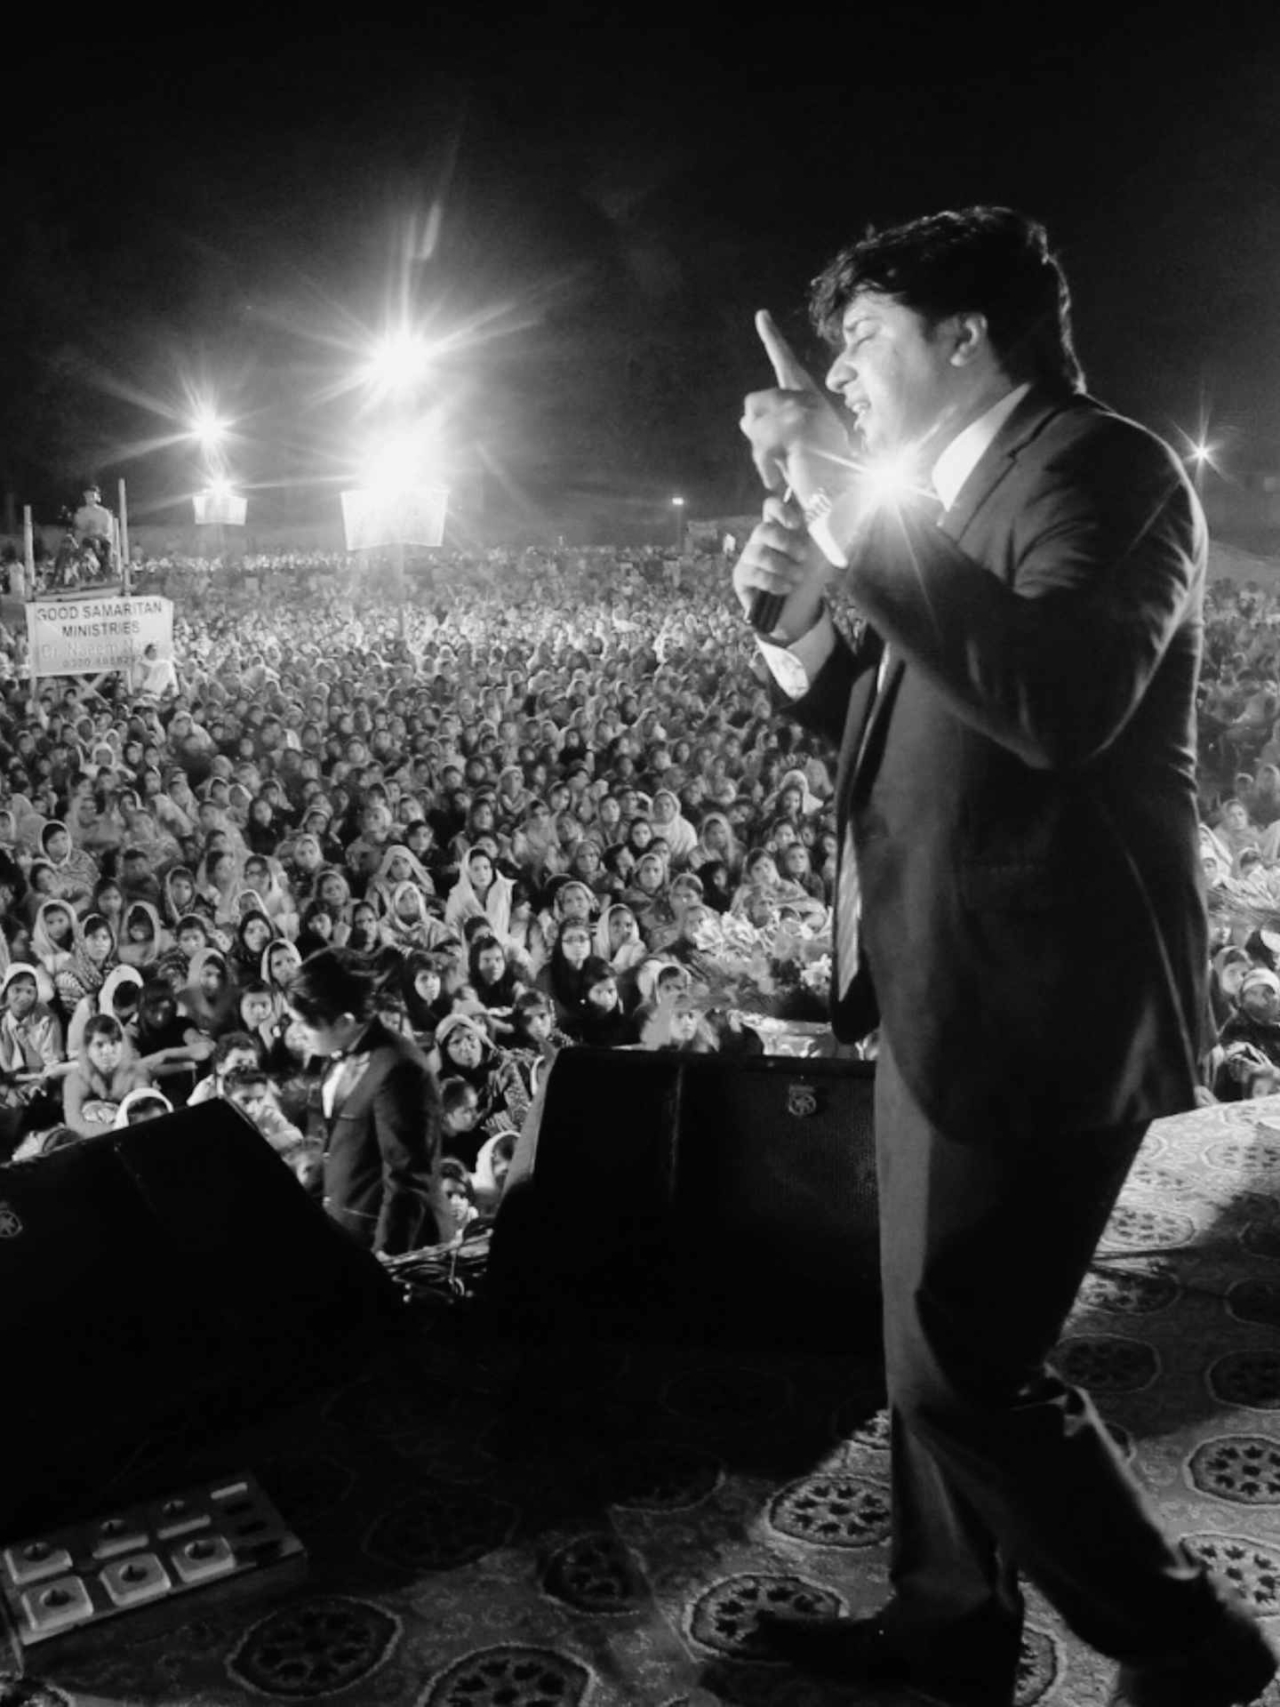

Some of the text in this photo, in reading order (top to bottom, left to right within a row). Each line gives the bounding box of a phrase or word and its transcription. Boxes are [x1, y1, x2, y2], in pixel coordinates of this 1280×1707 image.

[36, 601, 162, 621] GOOD SAMARITAN
[62, 620, 141, 638] MINISTRIES
